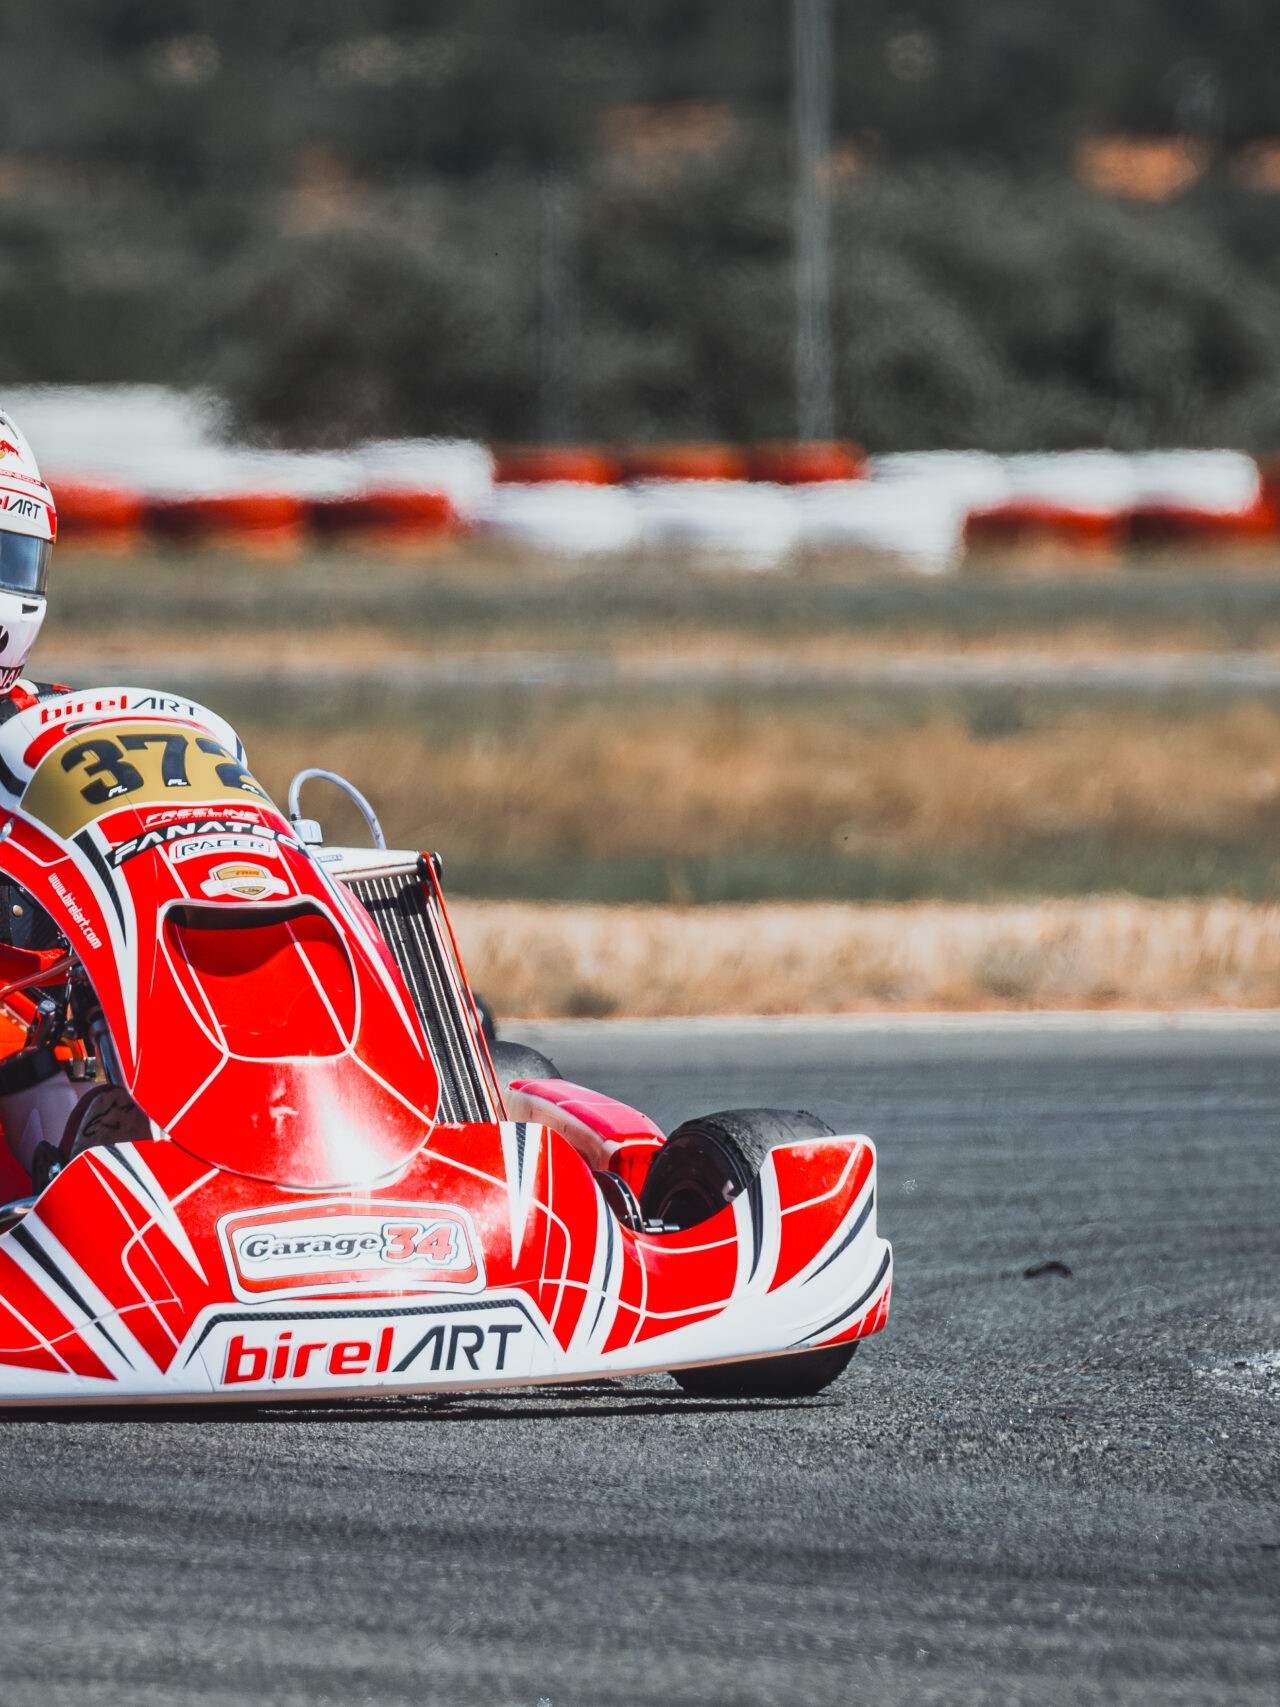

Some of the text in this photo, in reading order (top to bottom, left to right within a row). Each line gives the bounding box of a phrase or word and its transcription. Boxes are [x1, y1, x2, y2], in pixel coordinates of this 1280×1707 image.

[41, 695, 201, 725] birelART
[61, 734, 272, 804] 372
[144, 808, 261, 828] FREELINE
[181, 838, 265, 857] RACER
[48, 872, 102, 949] www.birelart.com
[246, 1224, 457, 1262] Garage 34
[220, 1325, 523, 1385] birelART
